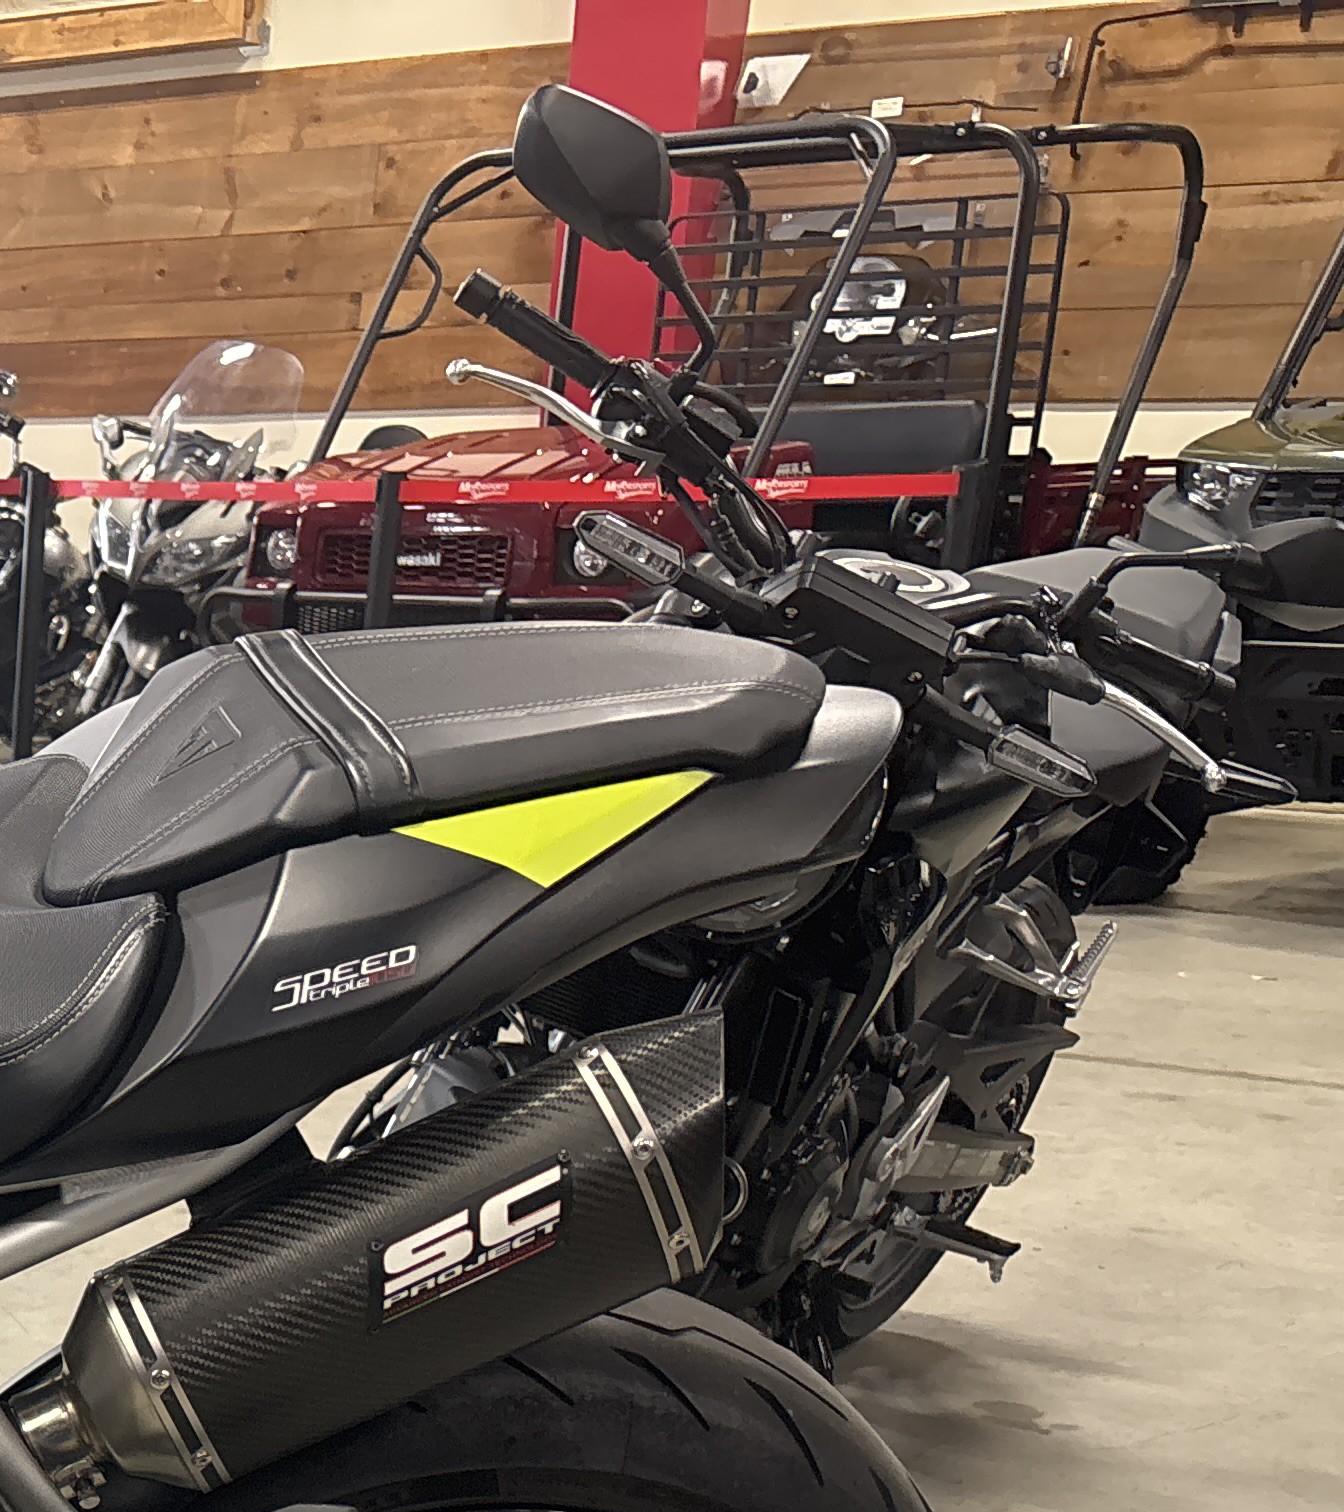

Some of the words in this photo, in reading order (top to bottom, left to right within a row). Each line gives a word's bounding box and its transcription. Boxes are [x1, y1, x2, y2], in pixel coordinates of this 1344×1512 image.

[396, 551, 442, 567] wasaki
[270, 944, 418, 1013] SPEED
[382, 1217, 562, 1311] PROJECT
[383, 1165, 562, 1297] SC
